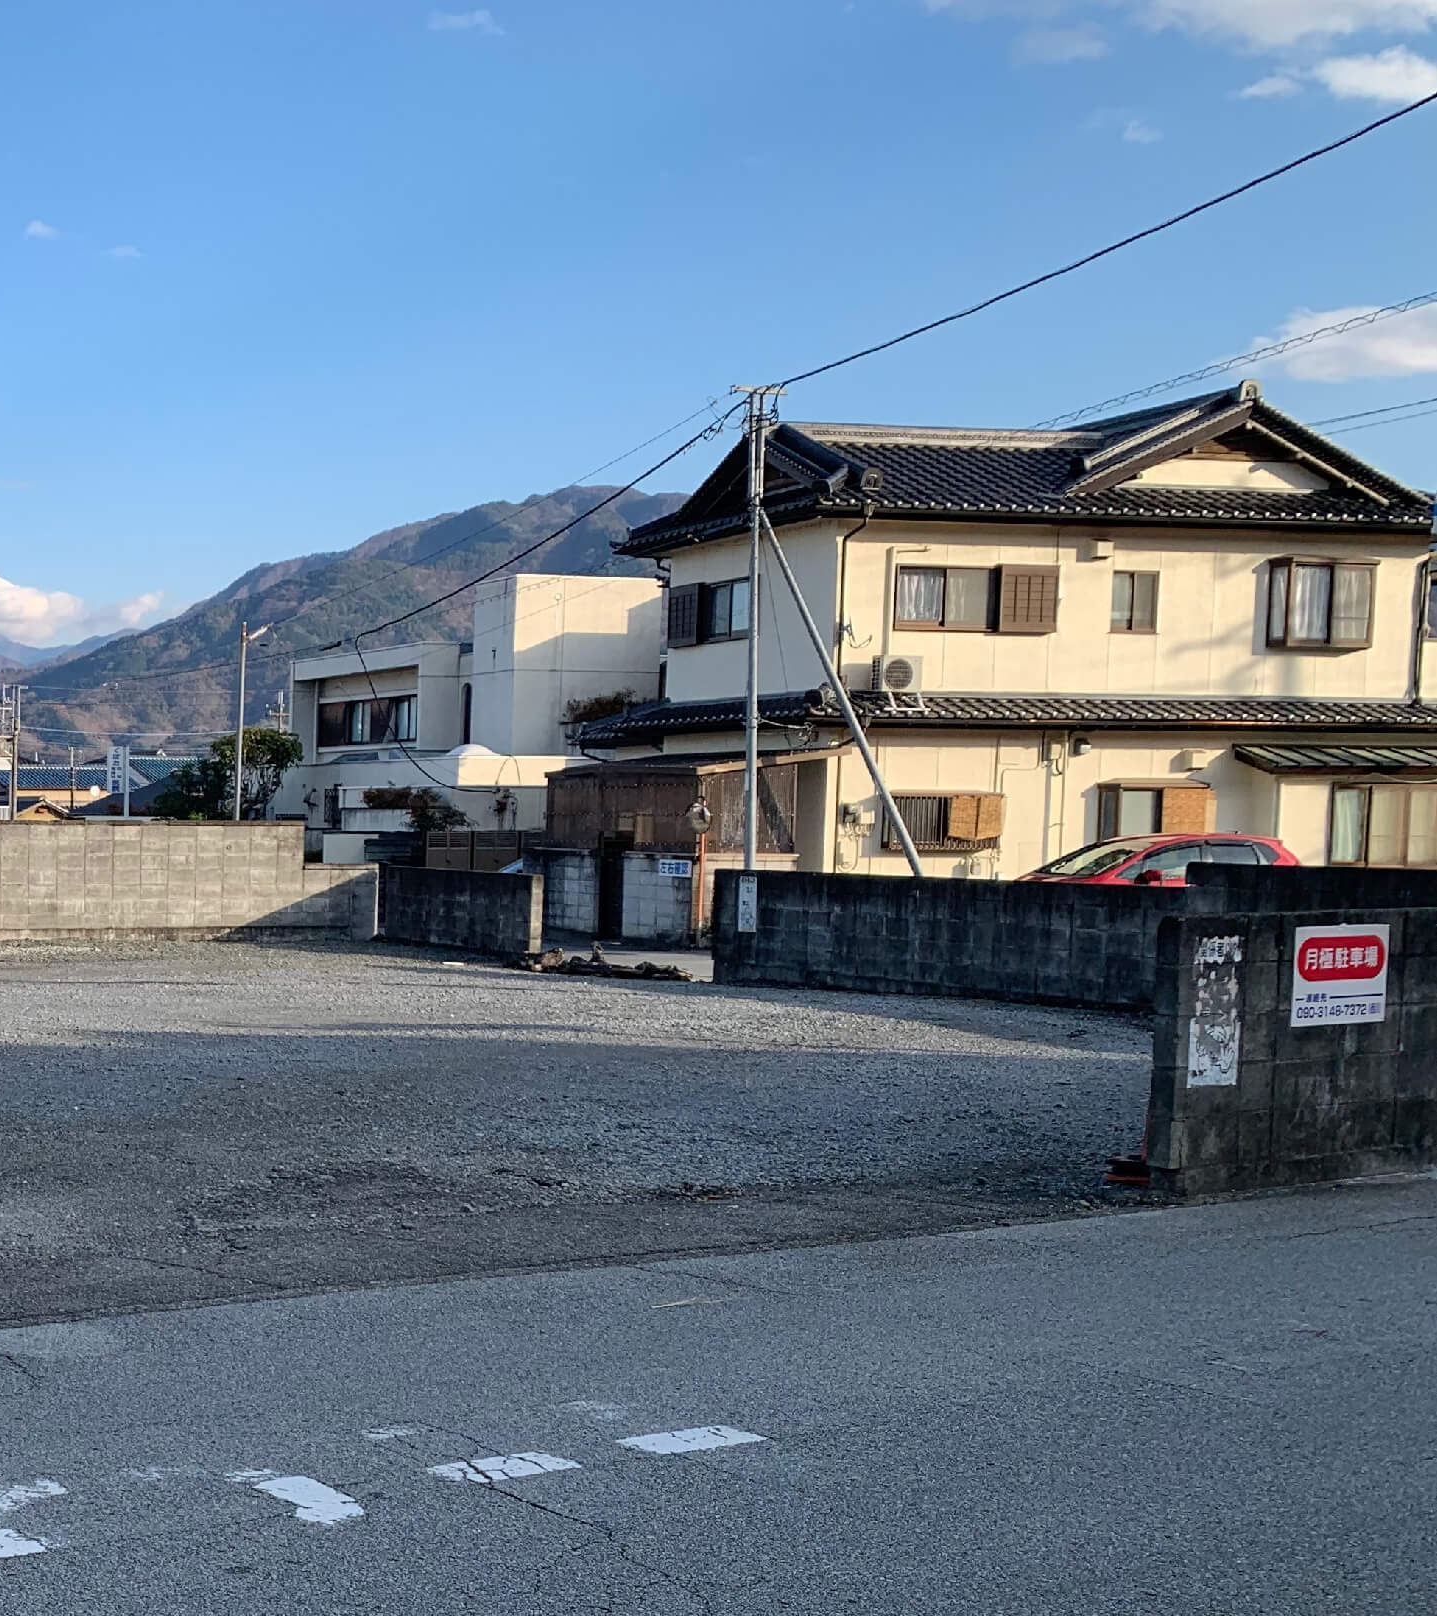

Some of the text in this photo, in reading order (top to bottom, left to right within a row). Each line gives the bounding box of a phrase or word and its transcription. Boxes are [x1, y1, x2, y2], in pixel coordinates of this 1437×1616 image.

[1305, 946, 1378, 971] 月極駐車場
[1297, 1003, 1367, 1019] 090-3148-7372
